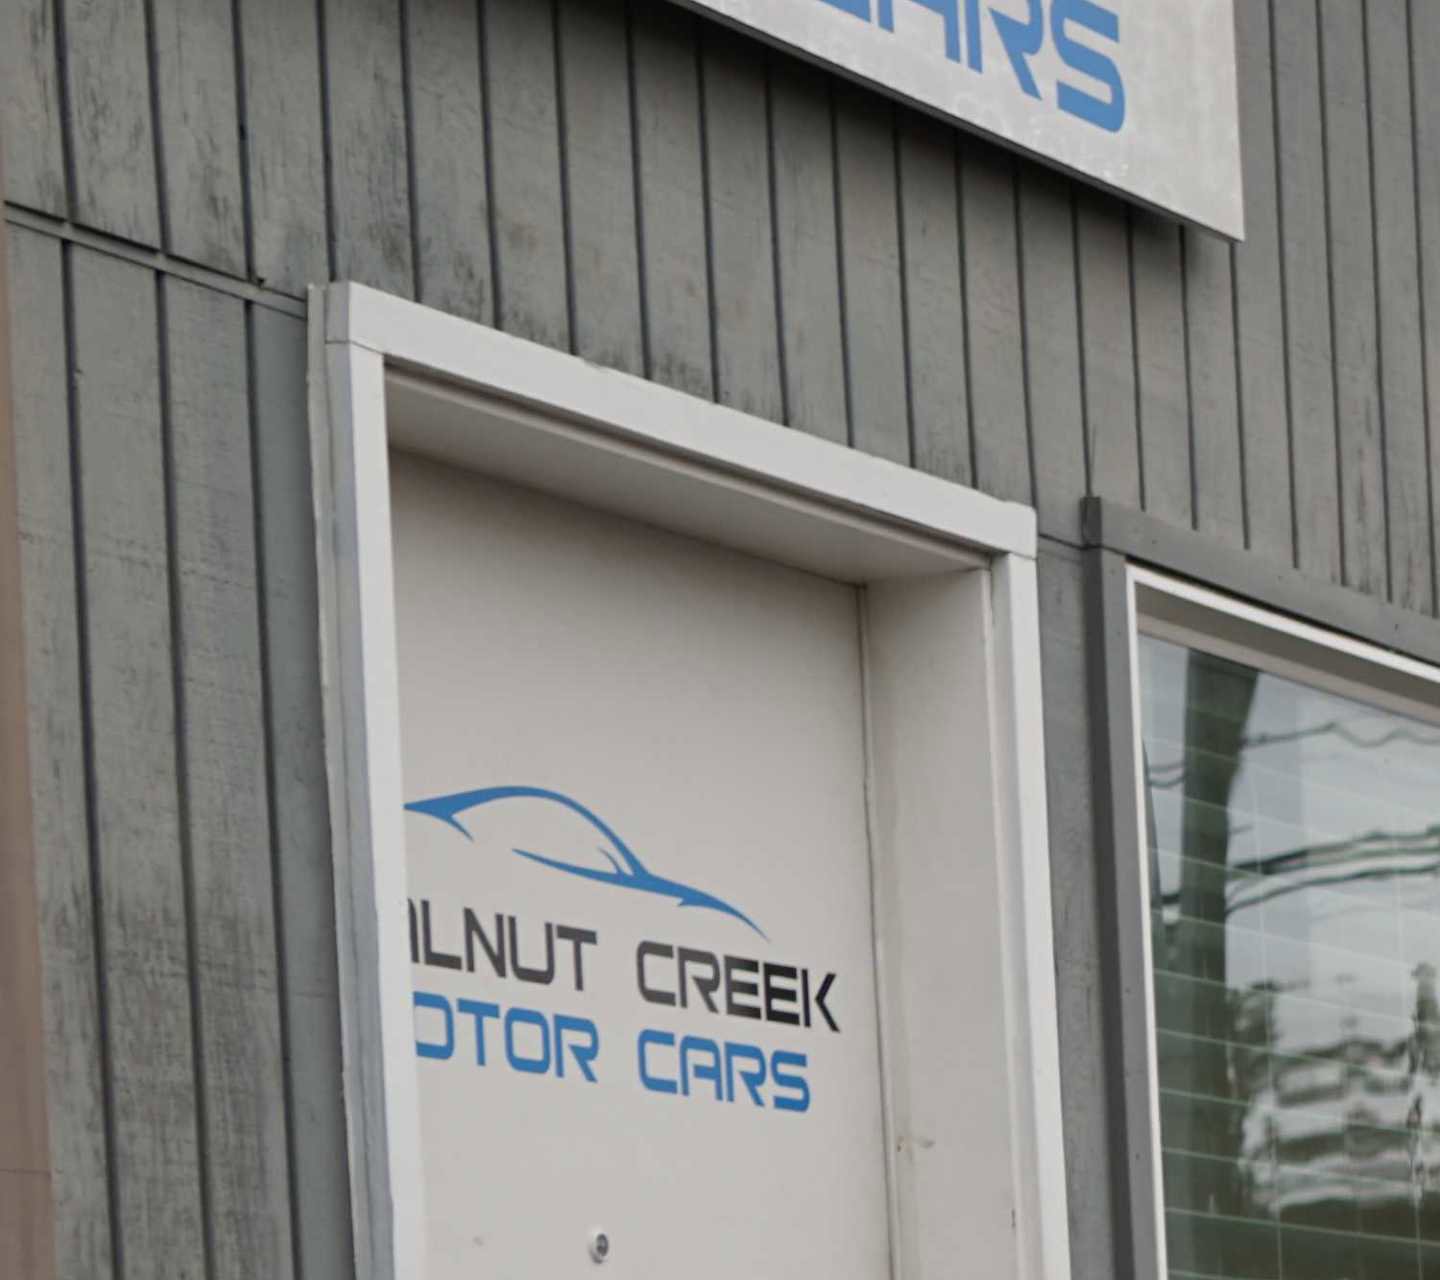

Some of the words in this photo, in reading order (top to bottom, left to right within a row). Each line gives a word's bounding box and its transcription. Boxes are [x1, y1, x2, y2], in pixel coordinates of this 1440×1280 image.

[818, 0, 1126, 133] RS
[407, 898, 598, 992] LNUT
[636, 939, 841, 1034] CREEK
[637, 1028, 811, 1114] CARS
